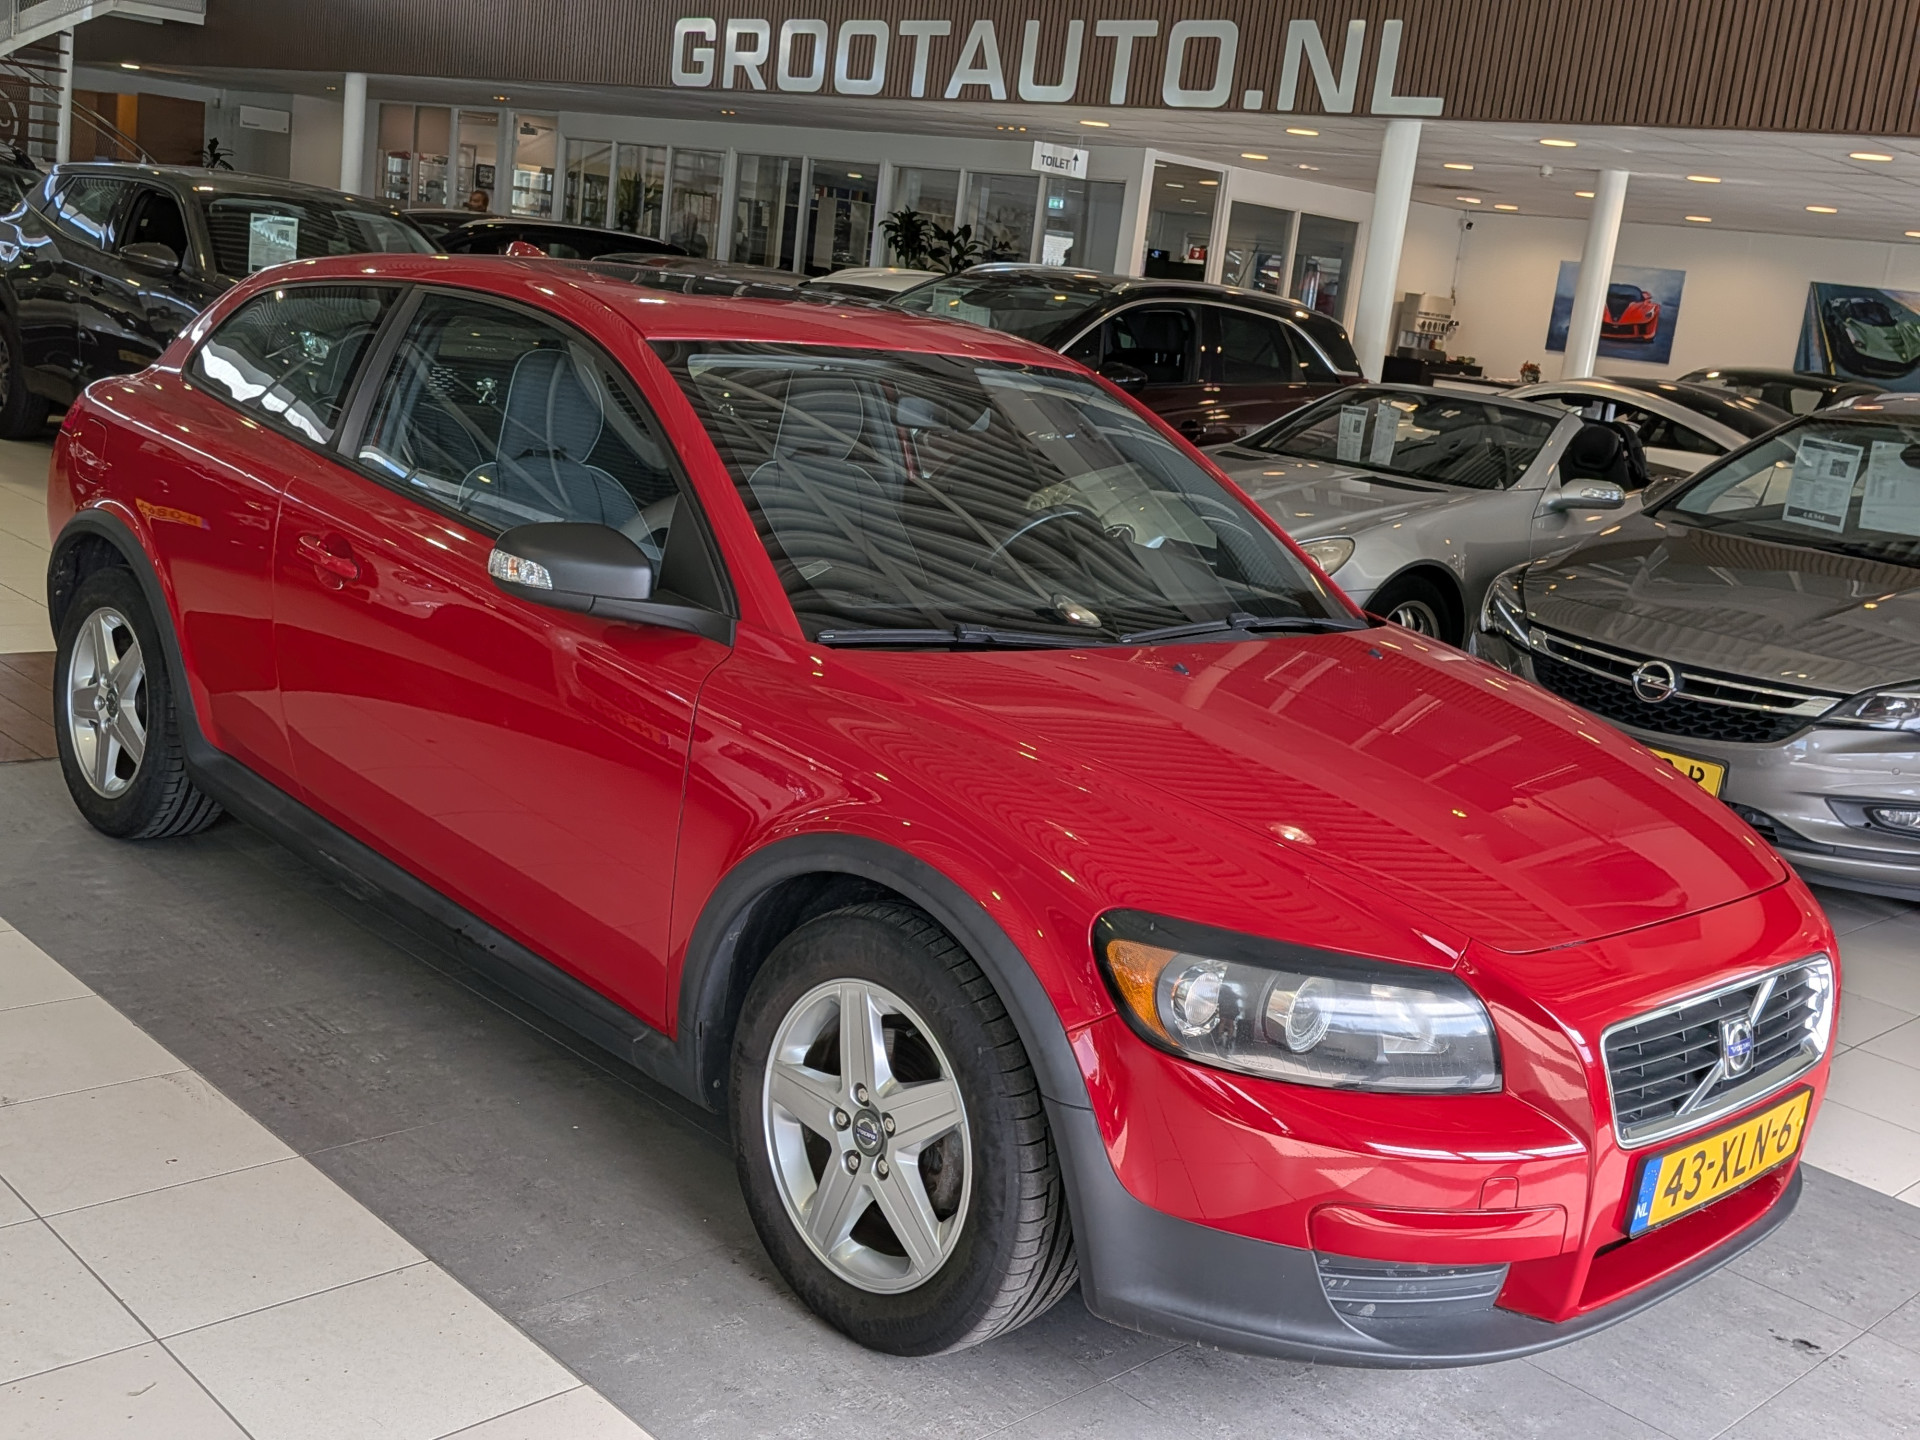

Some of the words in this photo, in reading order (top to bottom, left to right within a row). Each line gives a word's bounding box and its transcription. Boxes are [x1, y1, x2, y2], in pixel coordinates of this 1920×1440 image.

[672, 17, 1444, 117] GROOTAUTO.NL
[1041, 154, 1071, 170] TOILET
[1663, 1106, 1796, 1207] 43-XLN-6
[1635, 1201, 1649, 1220] NL
